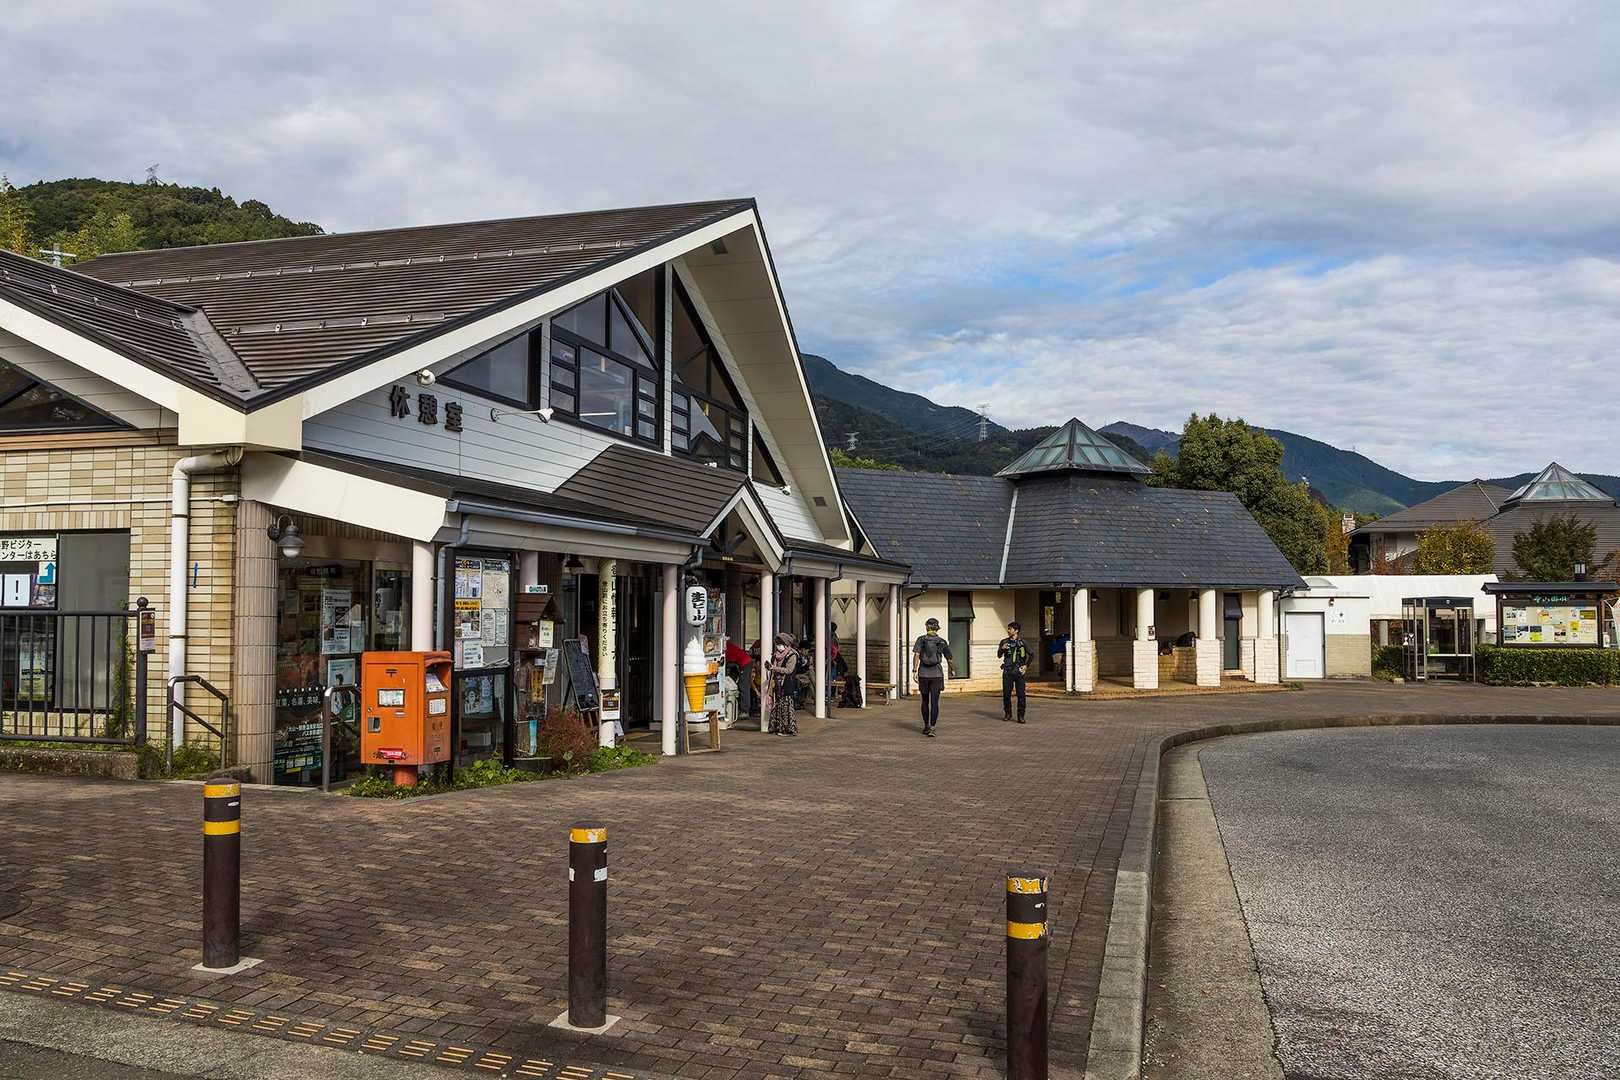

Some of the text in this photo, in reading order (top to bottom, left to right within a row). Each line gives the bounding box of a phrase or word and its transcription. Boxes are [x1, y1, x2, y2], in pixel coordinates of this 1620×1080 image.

[389, 384, 463, 432] 休憩室
[0, 540, 42, 550] 野ビジター
[0, 550, 57, 561] ンターはあちら
[691, 591, 706, 622] 生ビール
